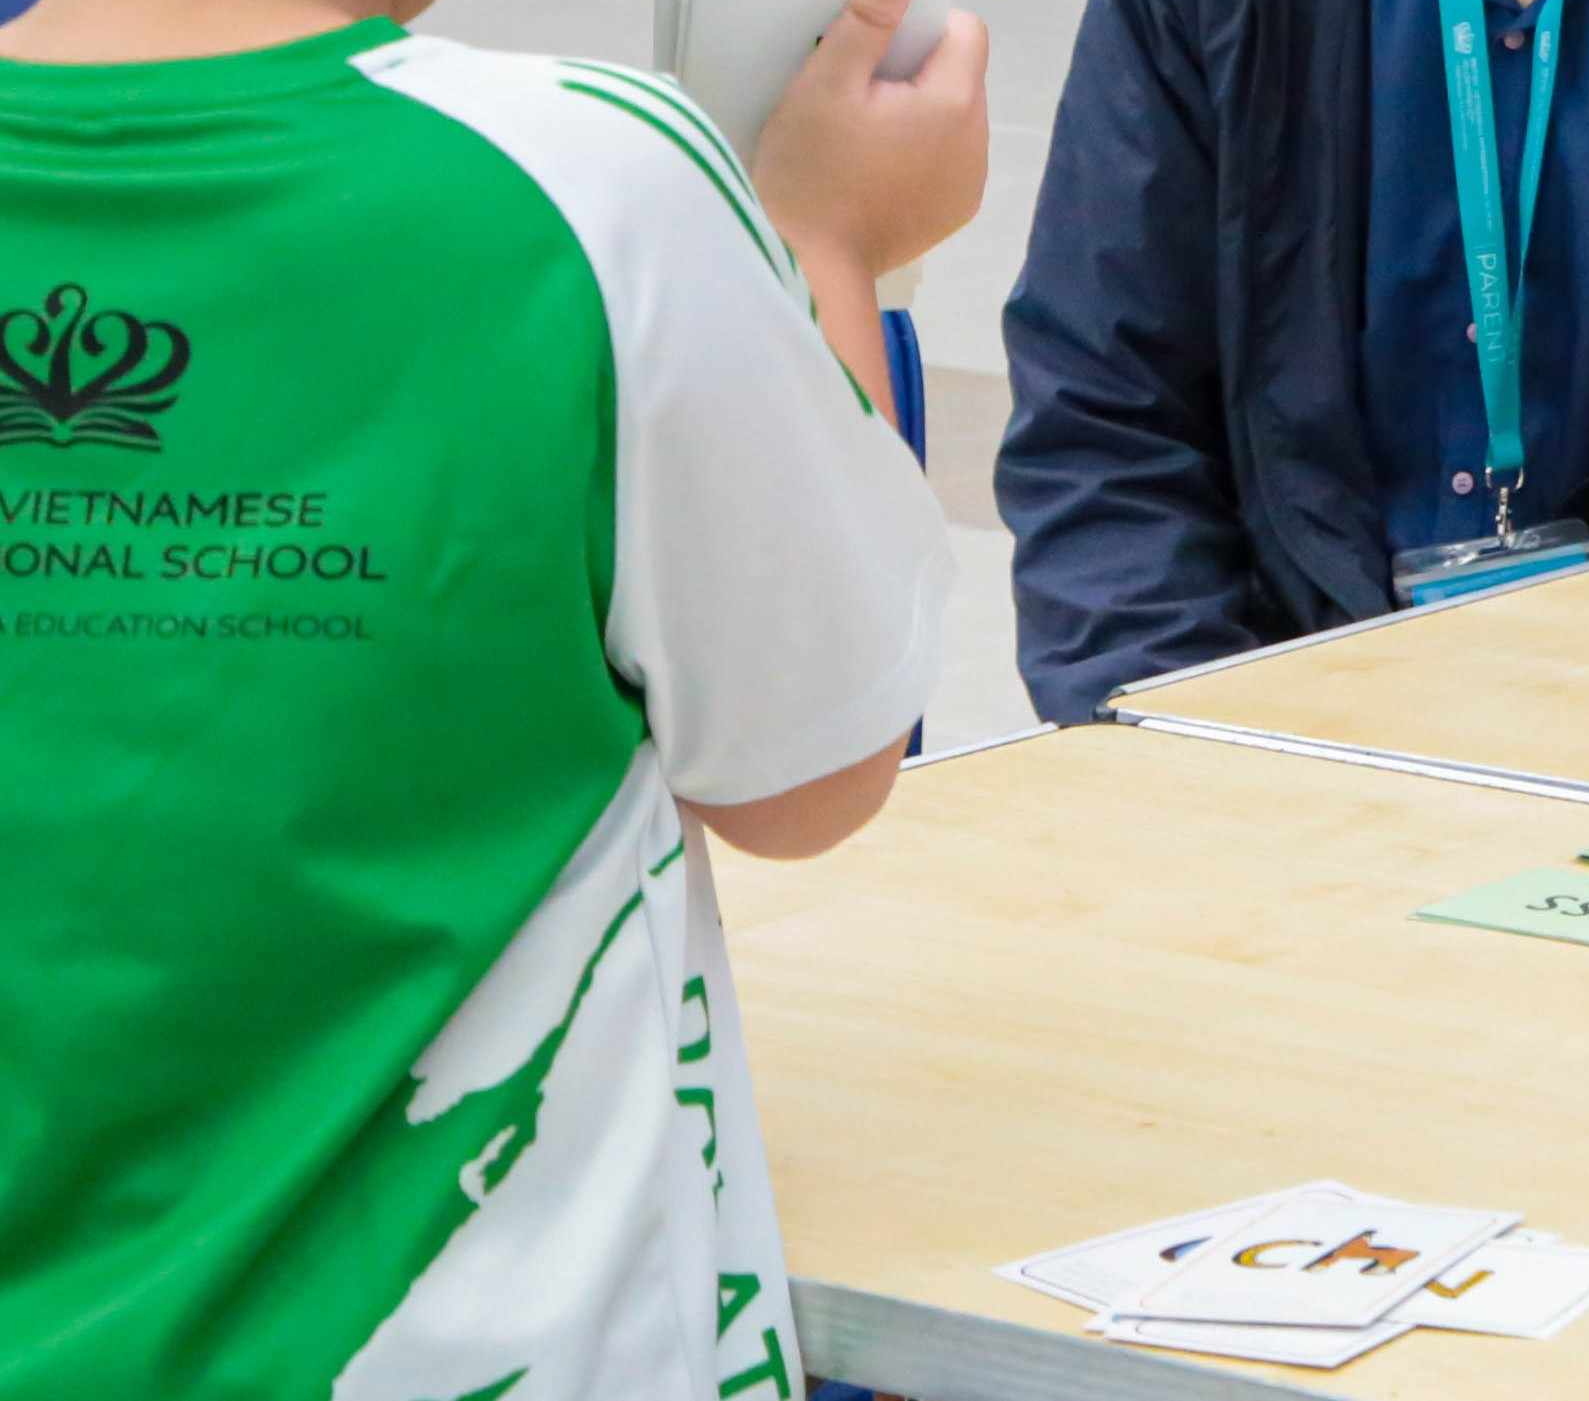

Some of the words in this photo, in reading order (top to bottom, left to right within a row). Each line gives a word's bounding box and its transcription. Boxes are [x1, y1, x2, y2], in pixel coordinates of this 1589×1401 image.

[1475, 252, 1506, 363] PARENT
[0, 489, 328, 528] VIETNAMESE
[160, 544, 389, 582] SCHOOL
[14, 611, 208, 639] EDUCATION
[216, 613, 375, 641] SCHOOL
